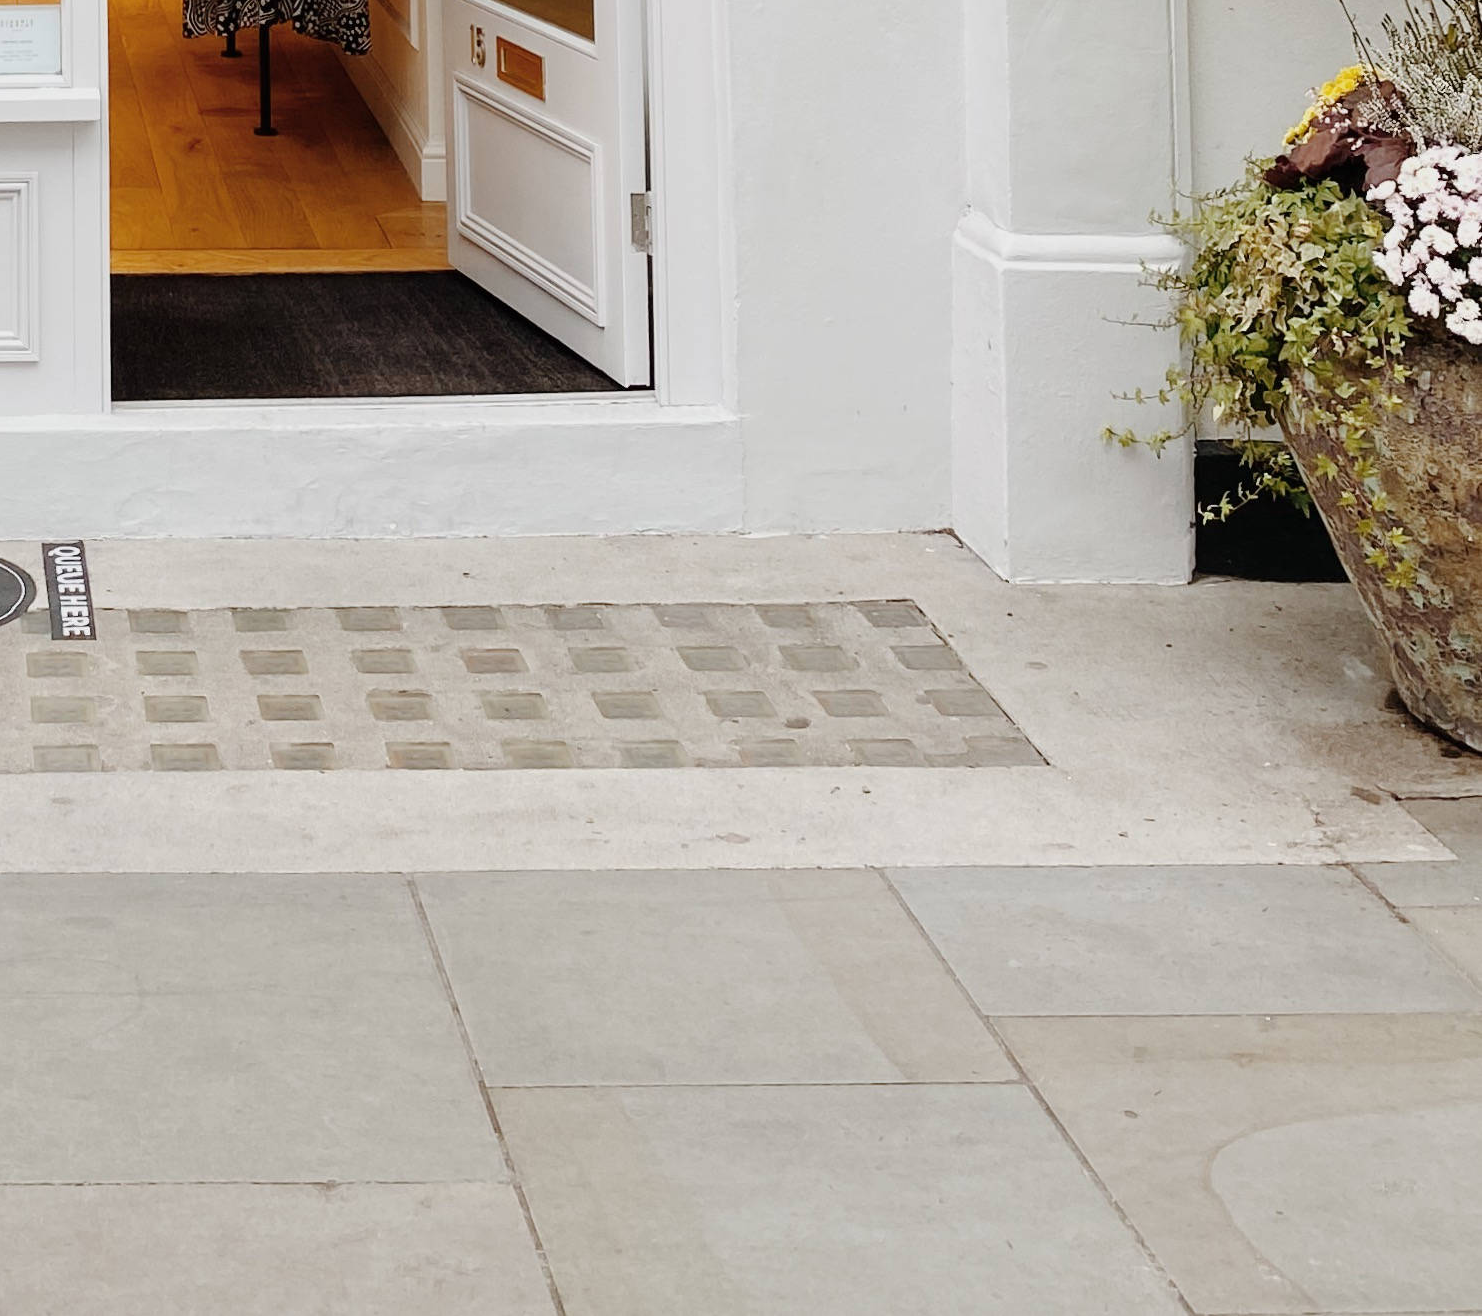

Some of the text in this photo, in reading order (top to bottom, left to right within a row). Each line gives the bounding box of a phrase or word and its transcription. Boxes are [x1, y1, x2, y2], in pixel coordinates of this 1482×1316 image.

[470, 24, 487, 68] 15
[47, 546, 91, 637] QUEUE HERE
